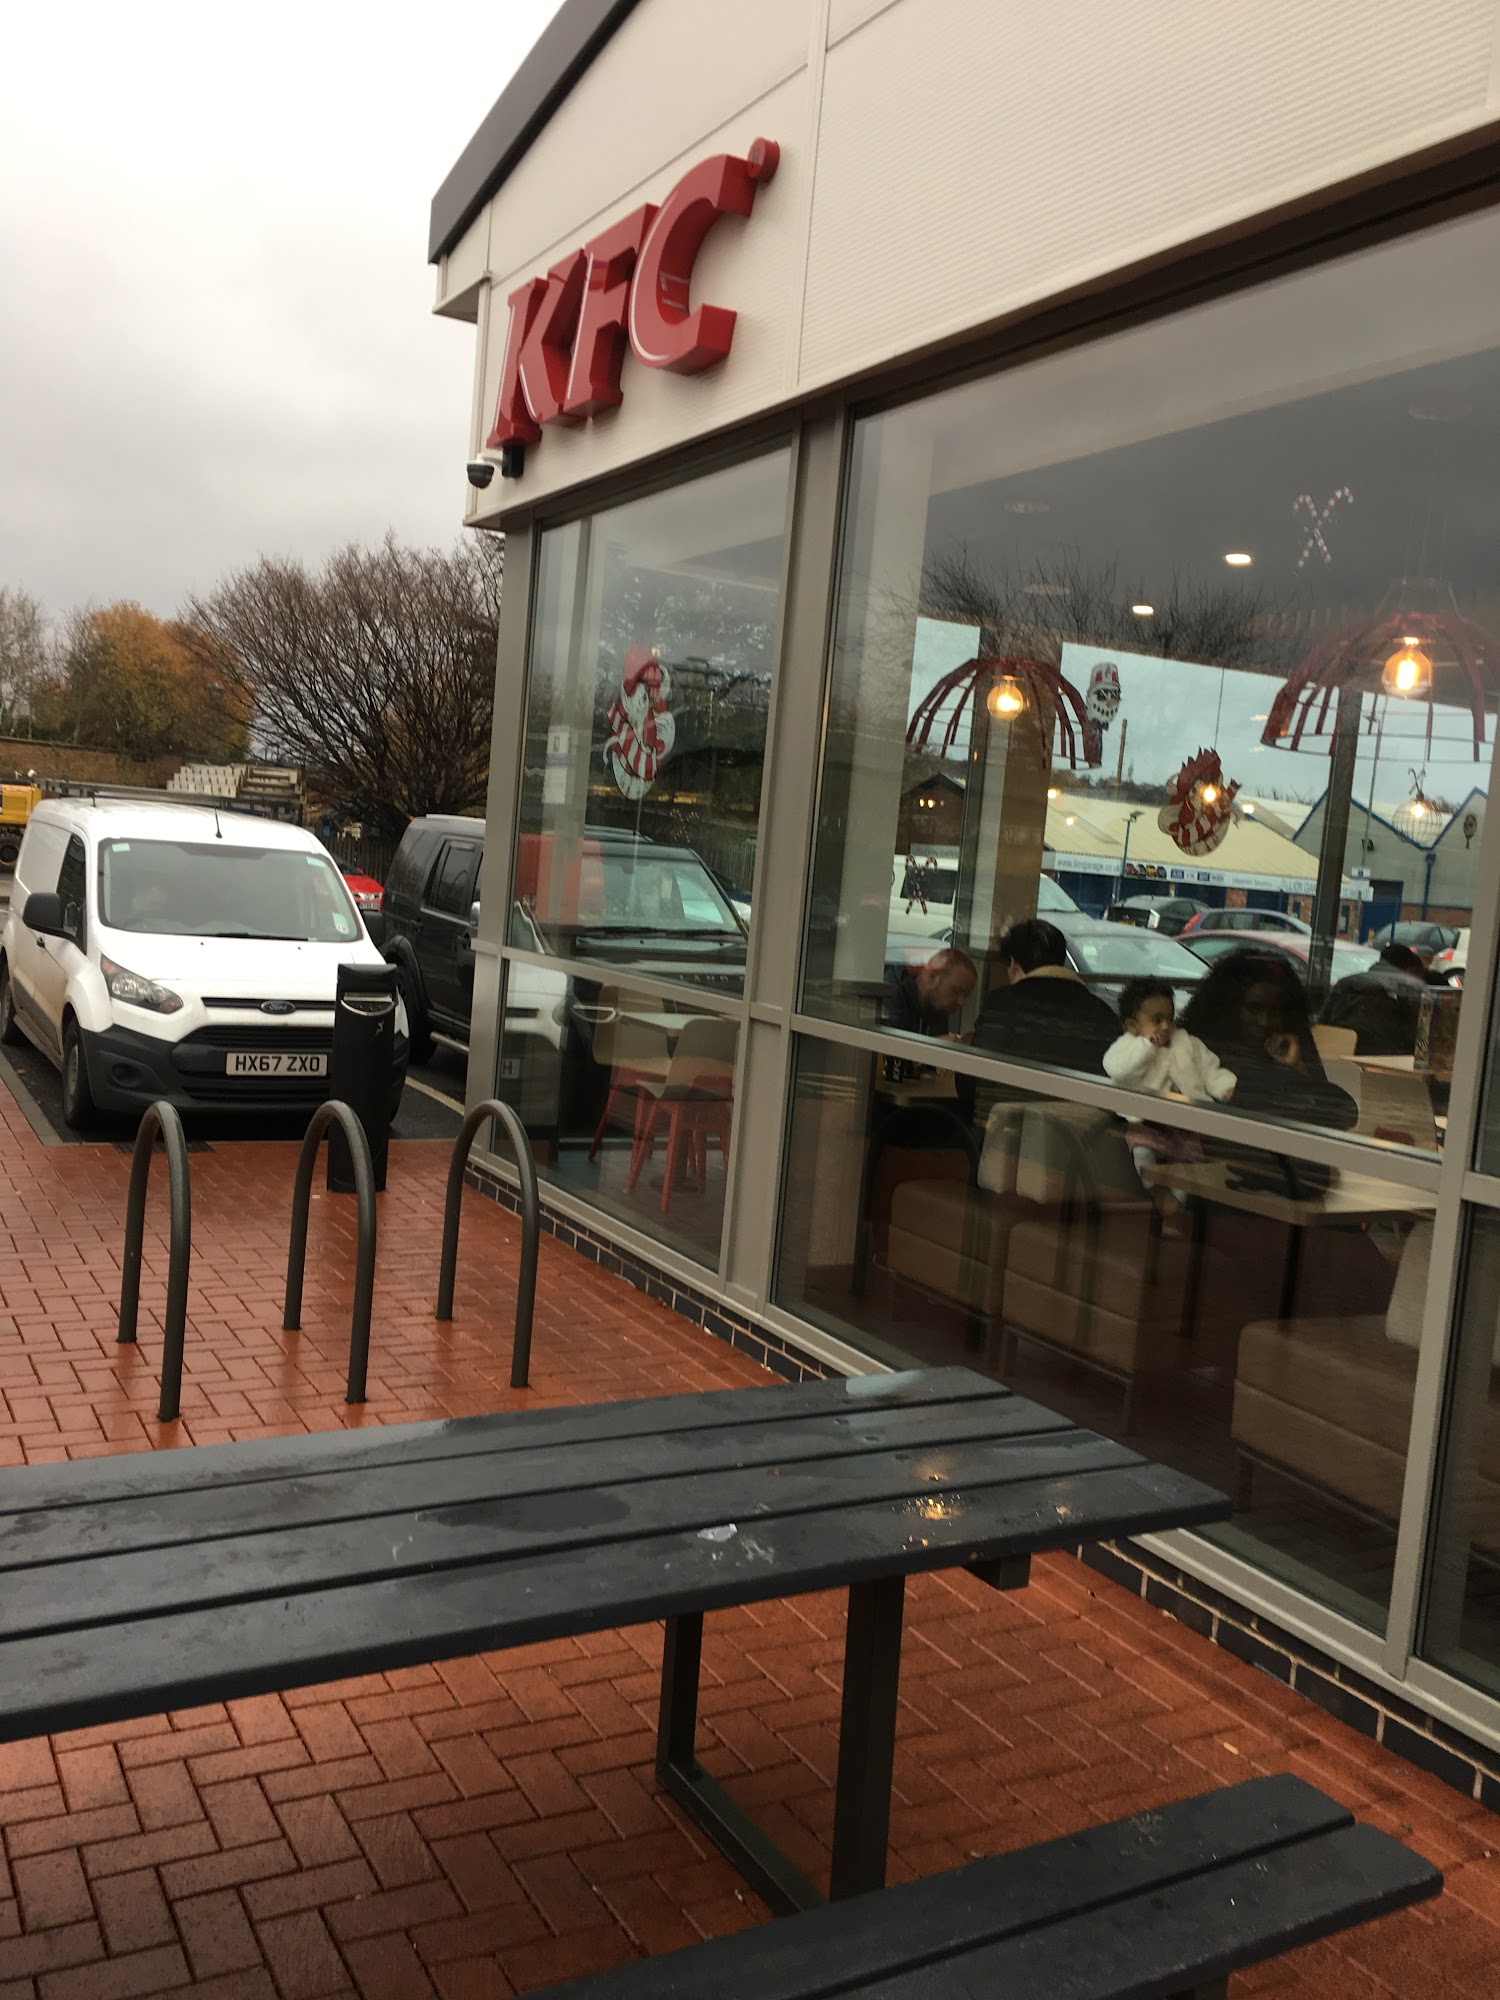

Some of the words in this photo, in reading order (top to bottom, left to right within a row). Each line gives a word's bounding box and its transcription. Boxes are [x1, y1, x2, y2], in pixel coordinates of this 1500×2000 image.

[486, 153, 757, 449] KFC
[235, 1055, 282, 1072] HX67
[286, 1056, 320, 1073] ZXO
